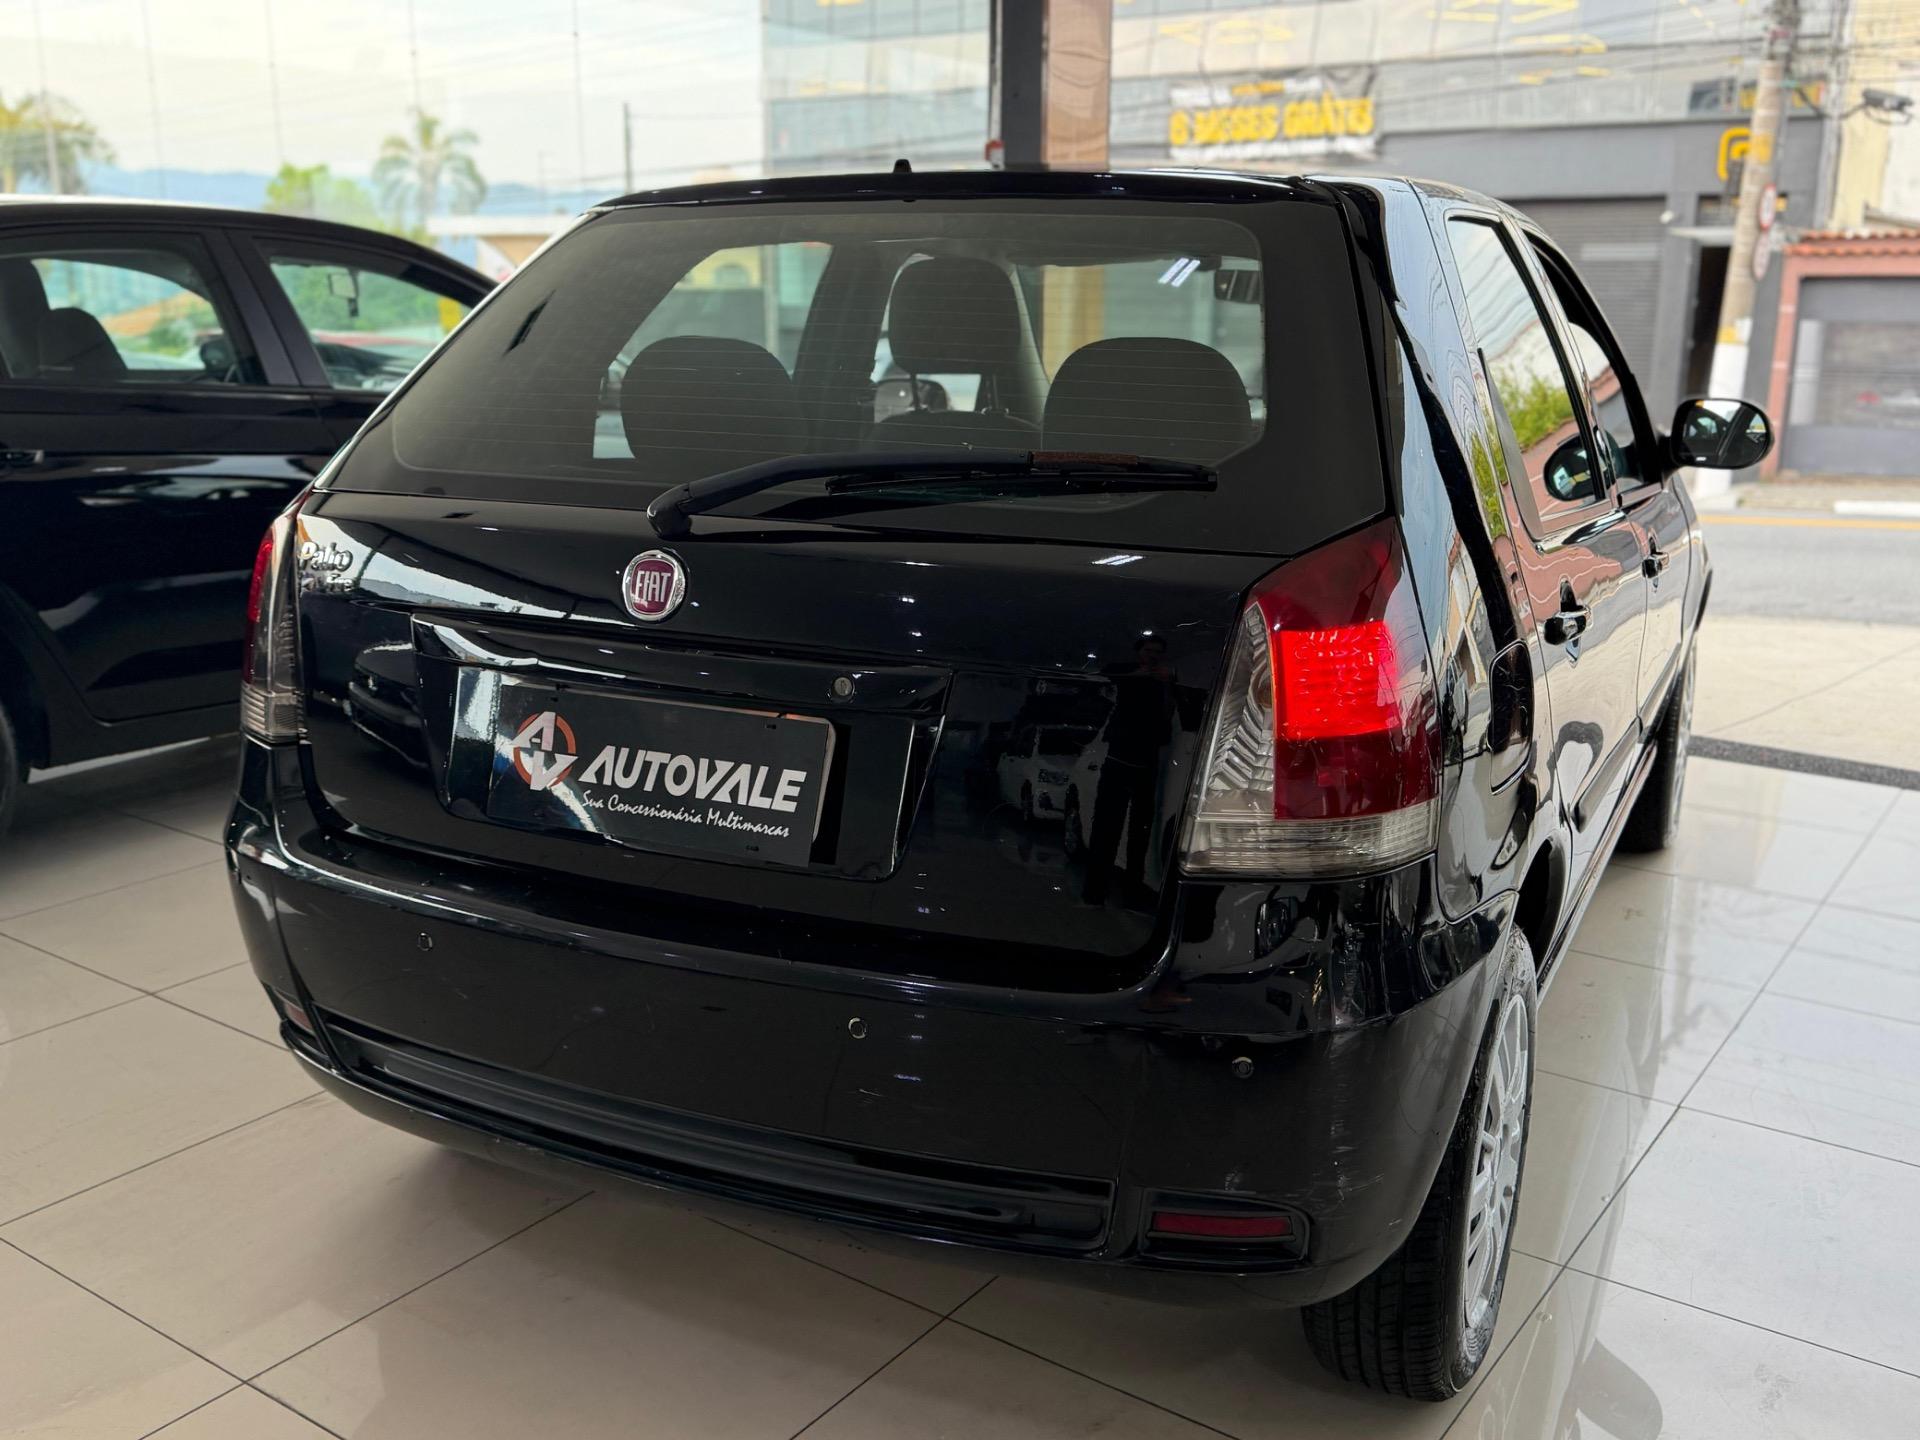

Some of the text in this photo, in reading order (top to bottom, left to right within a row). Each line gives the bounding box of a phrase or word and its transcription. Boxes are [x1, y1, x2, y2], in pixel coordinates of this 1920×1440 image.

[296, 541, 353, 572] Palio
[635, 570, 672, 603] FIAT
[578, 745, 808, 813] AUTOVALE
[582, 789, 790, 838] Sua Concessionária Multimarcas
